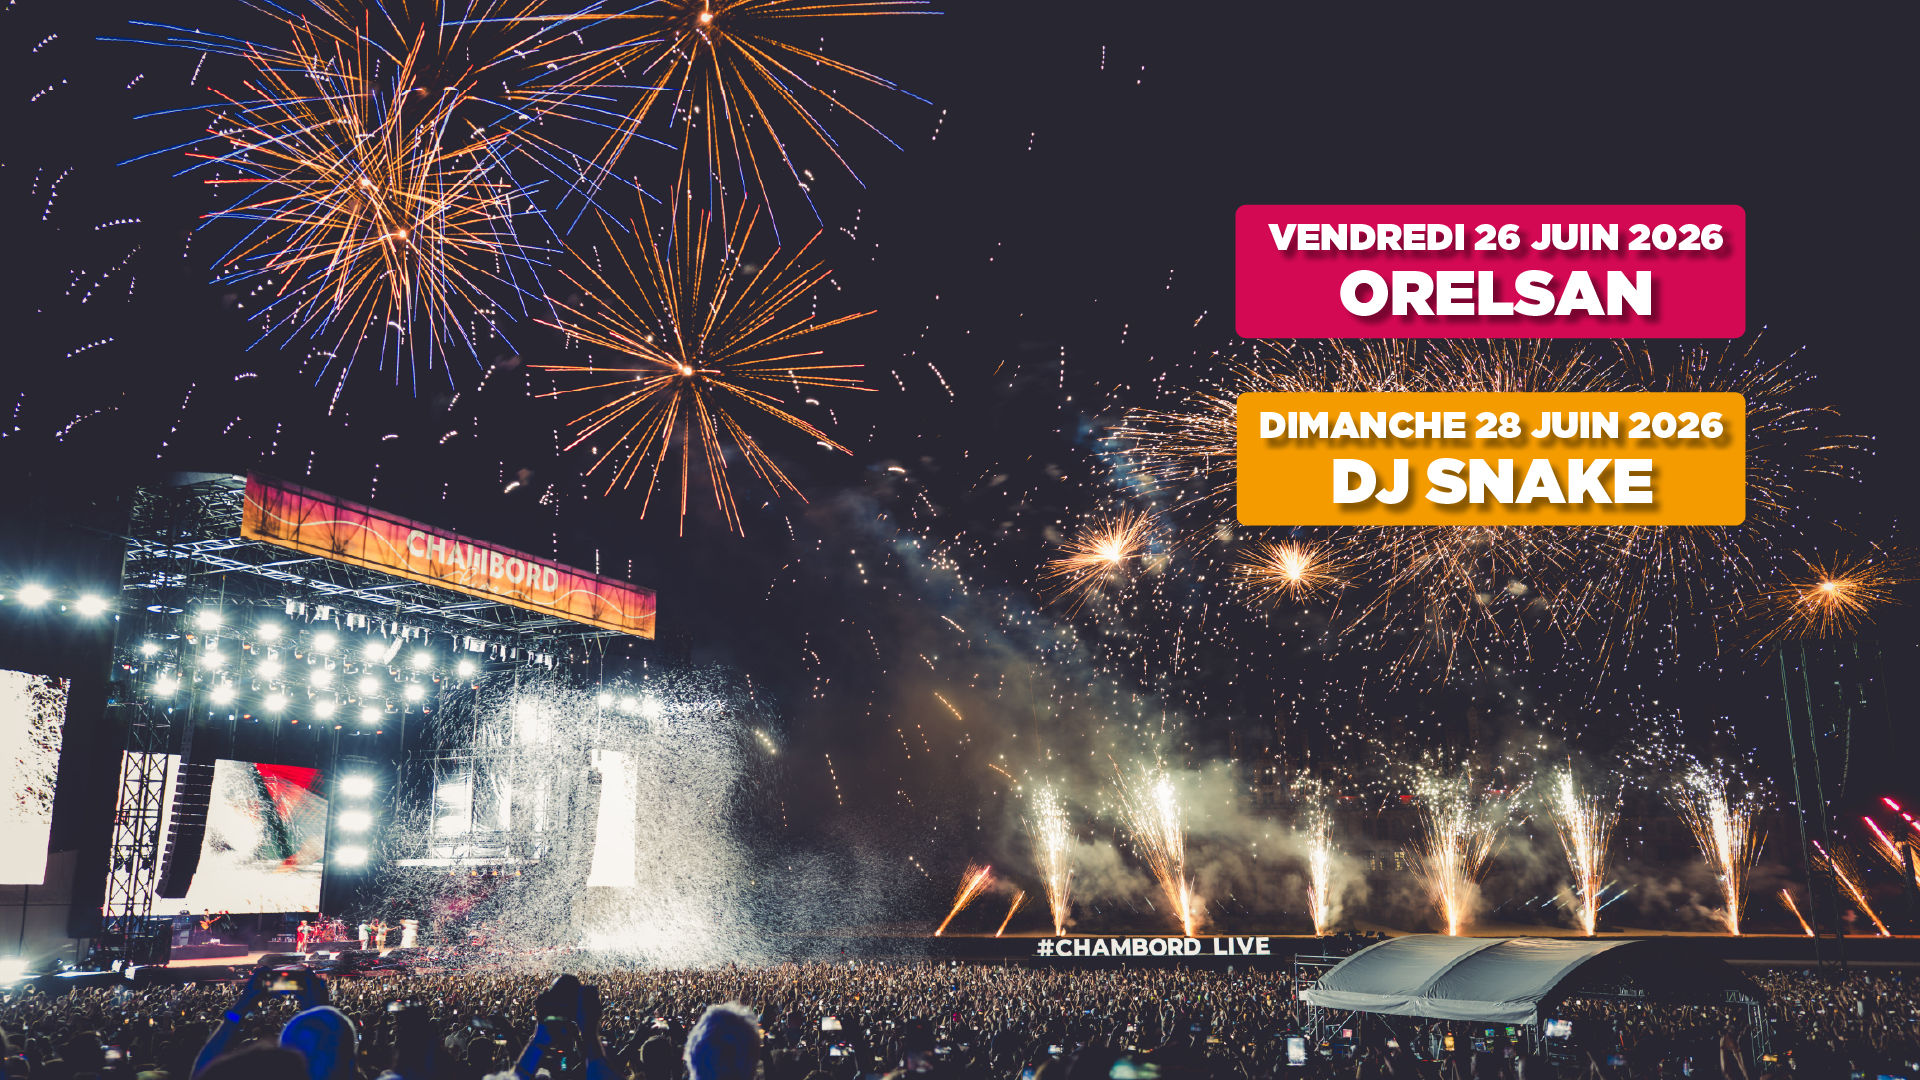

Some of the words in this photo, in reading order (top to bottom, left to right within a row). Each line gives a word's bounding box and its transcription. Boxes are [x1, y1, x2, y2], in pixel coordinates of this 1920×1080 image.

[406, 529, 559, 593] CHAMBORD
[1037, 937, 1201, 957] #CHAMBORD
[1213, 936, 1271, 956] LIVE
